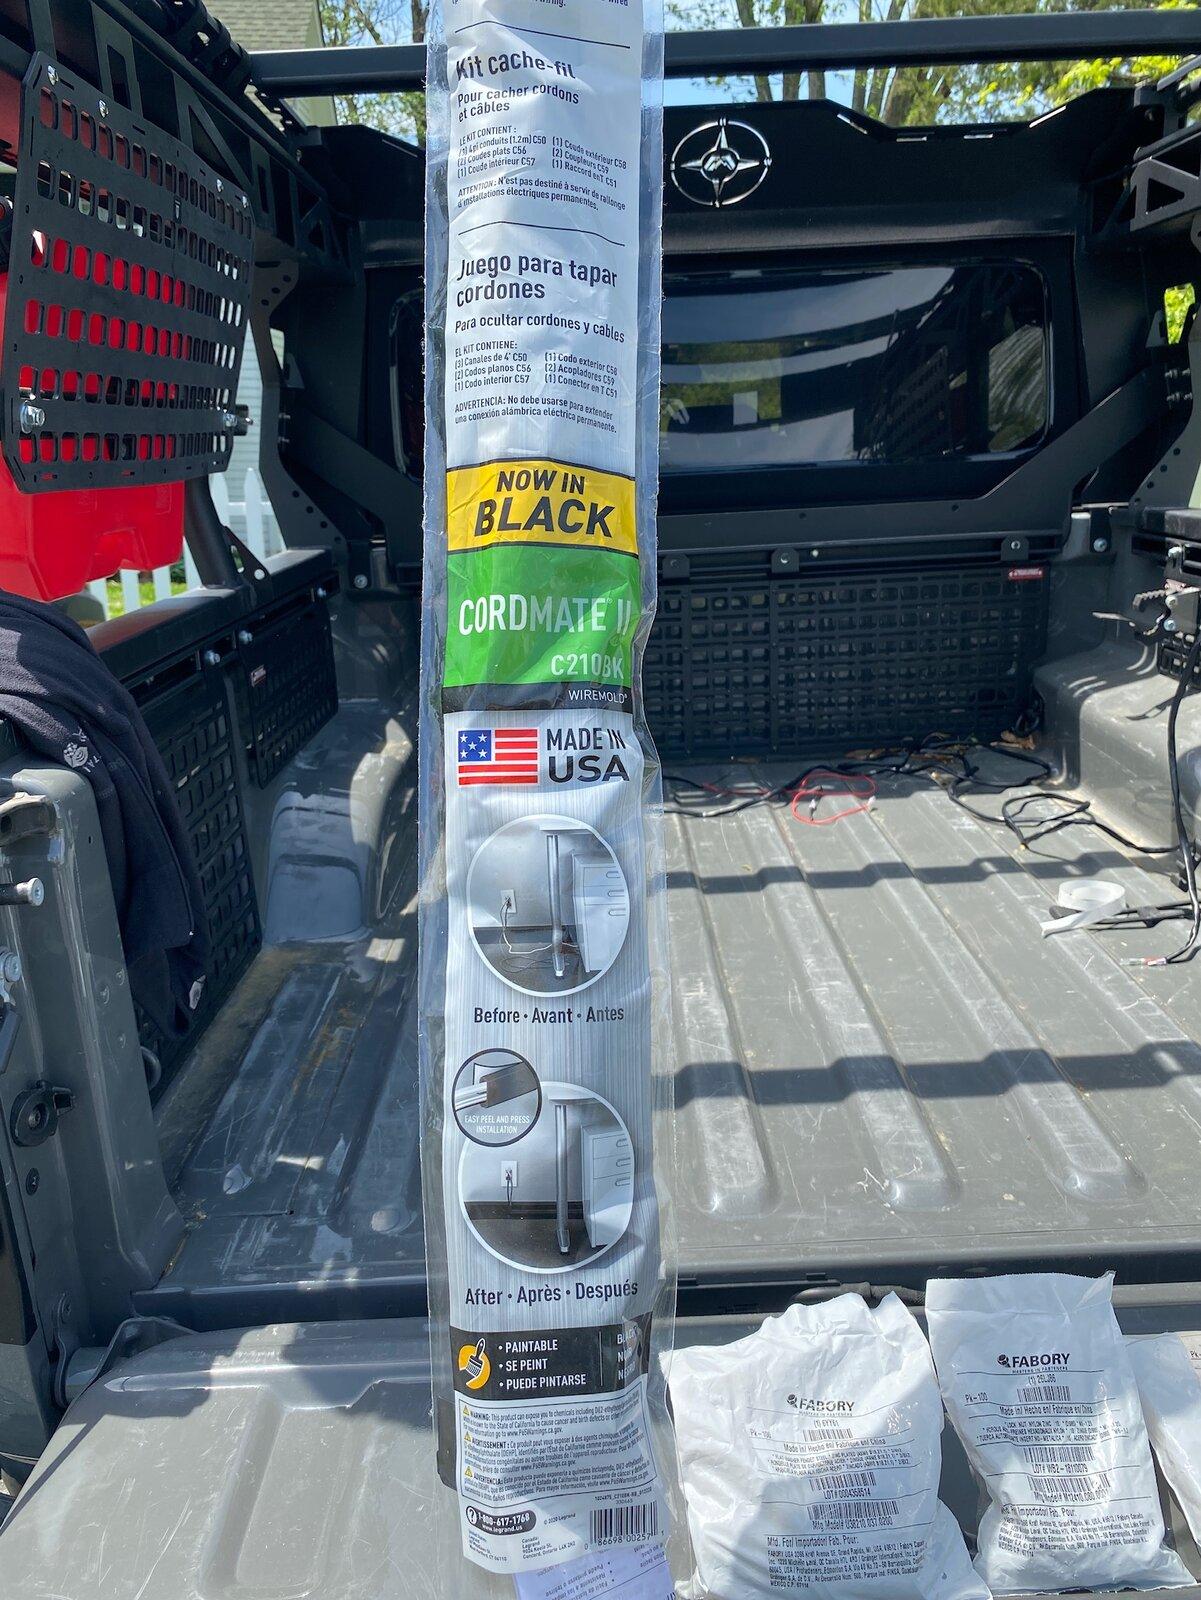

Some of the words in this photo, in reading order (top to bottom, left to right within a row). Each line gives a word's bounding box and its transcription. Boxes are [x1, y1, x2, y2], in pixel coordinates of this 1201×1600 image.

[456, 56, 484, 81] Kit
[488, 50, 576, 79] cache-fil
[458, 90, 483, 107] Pour
[486, 86, 529, 100] cacher
[532, 84, 579, 104] cordons
[458, 110, 467, 122] et
[470, 100, 510, 117] câbles
[459, 137, 467, 146] LE
[466, 131, 476, 143] KIT
[477, 126, 512, 138] CONTIENT
[479, 137, 509, 150] conduits
[533, 136, 547, 145] C50
[458, 156, 467, 166] (2)
[467, 151, 491, 163] Coudes
[492, 147, 511, 157] plats
[512, 146, 527, 154] C56
[552, 136, 563, 148] (1)
[565, 140, 584, 152] Coude
[585, 146, 613, 165] extérieur
[614, 158, 627, 169] C58
[552, 148, 563, 158] (2)
[565, 151, 596, 169] Coupleurs
[597, 164, 609, 174] C59
[457, 167, 467, 178] (1)
[468, 162, 488, 174] Coude
[489, 158, 519, 170] intérieur
[521, 157, 536, 166] C57
[552, 159, 563, 169] (1)
[565, 159, 591, 177] Raccord
[605, 178, 617, 188] C51
[498, 176, 518, 186] N'est
[519, 178, 533, 186] pas
[534, 178, 563, 188] destiné
[564, 180, 569, 190] à
[570, 183, 590, 195] servir
[591, 190, 600, 199] de
[600, 194, 626, 211] rallonge
[506, 186, 549, 199] électriques
[551, 192, 599, 211] permanentes.
[457, 255, 511, 281] Juego
[518, 255, 563, 276] para
[569, 260, 618, 288] tapar
[457, 280, 545, 308] cordones
[455, 317, 476, 333] Para
[480, 314, 523, 326] ocultar
[526, 314, 580, 331] cordones
[583, 322, 590, 334] y
[593, 321, 625, 343] cables
[455, 348, 462, 358] EL
[464, 344, 474, 355] KIT
[475, 340, 518, 352] CONTIENE:
[455, 358, 463, 369] (3)
[464, 355, 492, 367] Canales
[512, 353, 527, 362] C50
[455, 370, 464, 380] (2)
[465, 366, 487, 377] Codos
[488, 364, 514, 375] planos
[516, 363, 531, 372] C56
[545, 353, 556, 362] (1)
[558, 353, 577, 364] Codo
[578, 356, 605, 371] exterior
[606, 364, 618, 376] C58
[455, 381, 464, 392] (1)
[465, 379, 483, 389] Codo
[484, 375, 512, 386] interior
[514, 375, 530, 384] C57
[545, 363, 556, 373] (2)
[558, 364, 602, 382] Acopladores
[602, 375, 615, 386] C59
[545, 373, 556, 383] (1)
[558, 375, 590, 391] Conector
[591, 385, 600, 394] en
[600, 387, 605, 395] T
[605, 388, 618, 398] C51
[455, 395, 506, 413] ADVERTENCIA:
[508, 395, 519, 404] No
[520, 395, 539, 404] debe
[541, 397, 568, 406] usarse
[569, 400, 584, 411] para
[585, 404, 613, 421] extender
[455, 415, 467, 424] una
[468, 408, 500, 422] conexión
[501, 406, 541, 417] alámbrica
[543, 406, 576, 422] eléctrica
[576, 415, 617, 434] permanente.
[496, 469, 558, 493] NOW
[561, 473, 585, 495] IN
[474, 496, 616, 538] BLACK
[551, 653, 624, 680] C210BK
[546, 728, 603, 751] MADE
[606, 728, 626, 750] IN
[549, 754, 630, 783] USA
[474, 1007, 520, 1024] Before
[532, 1007, 573, 1024] Avant
[586, 1006, 624, 1023] Antes
[465, 1115, 480, 1123] EASY
[510, 1115, 530, 1123] PRESS
[476, 1125, 518, 1134] INSTALLATION
[465, 1288, 502, 1305] After
[517, 1284, 562, 1306] Après
[575, 1279, 638, 1302] Después
[505, 1339, 558, 1353] PAINTABLE
[506, 1360, 518, 1371] SE
[520, 1358, 548, 1371] PEINT
[1012, 1353, 1070, 1368] FABORY
[506, 1377, 538, 1390] PUEDE
[538, 1374, 586, 1388] PINTARSE
[800, 1398, 855, 1411] FABORY
[1000, 1406, 1014, 1416] Made
[1025, 1406, 1041, 1414] Hecho
[1052, 1405, 1073, 1415] Fabrique
[784, 1443, 800, 1452] Made
[808, 1443, 825, 1452] Hecho
[478, 1512, 530, 1526] 1-800-617-1768
[482, 1524, 523, 1533] www.legrand.us
[598, 1537, 623, 1546] 86698
[626, 1533, 651, 1542] 00257
